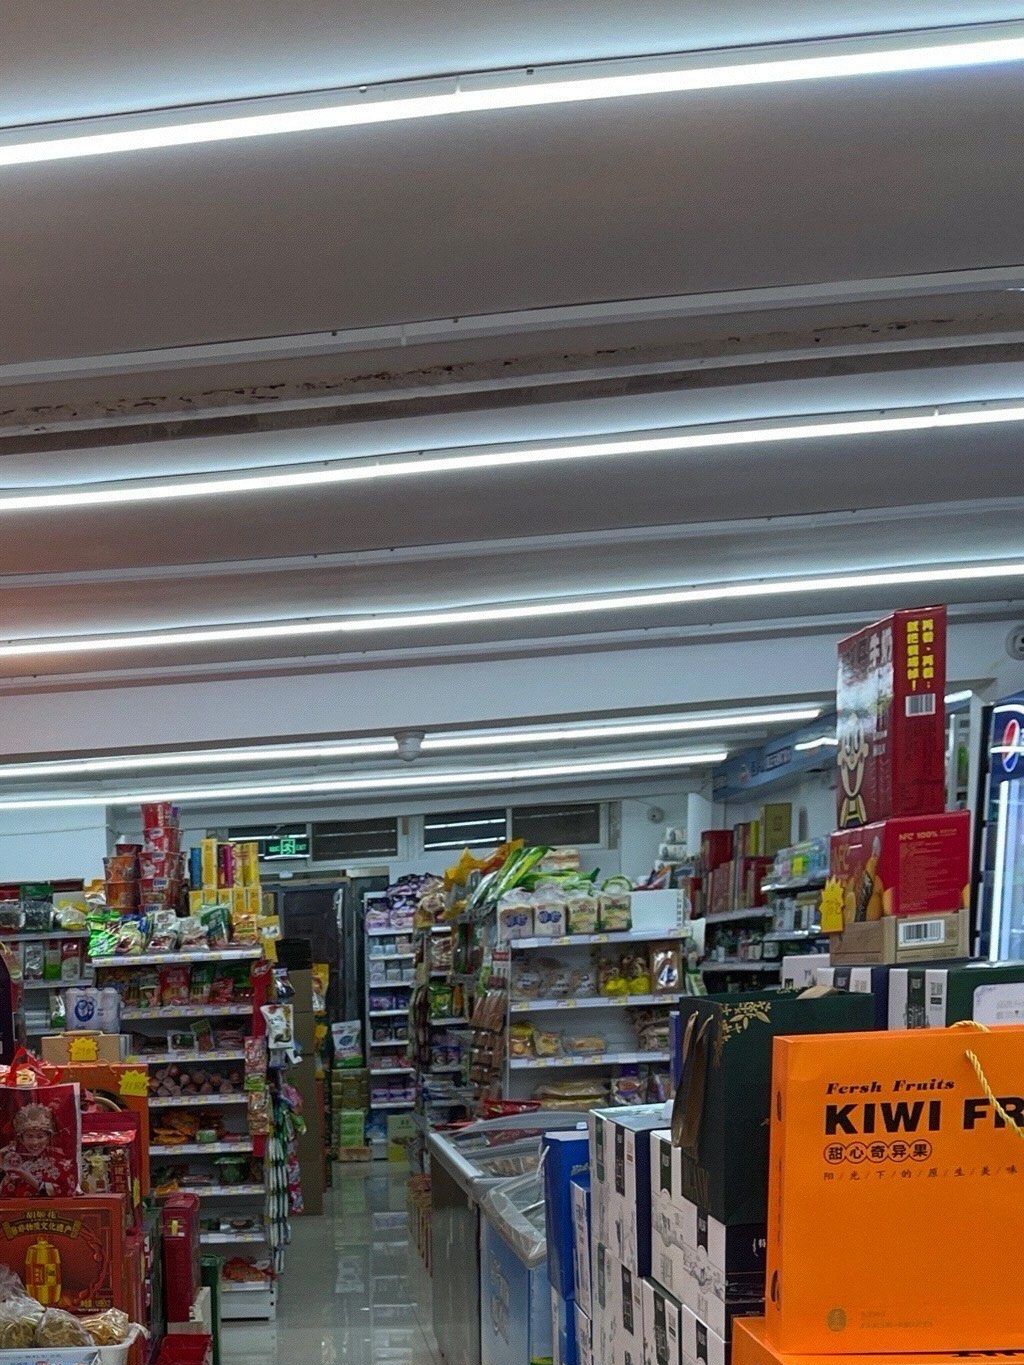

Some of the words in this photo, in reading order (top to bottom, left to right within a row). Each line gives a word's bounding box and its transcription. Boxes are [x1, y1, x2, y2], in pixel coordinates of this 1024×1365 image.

[825, 1081, 882, 1095] Fersh
[892, 1079, 956, 1092] Fruits
[825, 1100, 942, 1135] KIWI
[828, 1142, 929, 1161] 甜心奇异果
